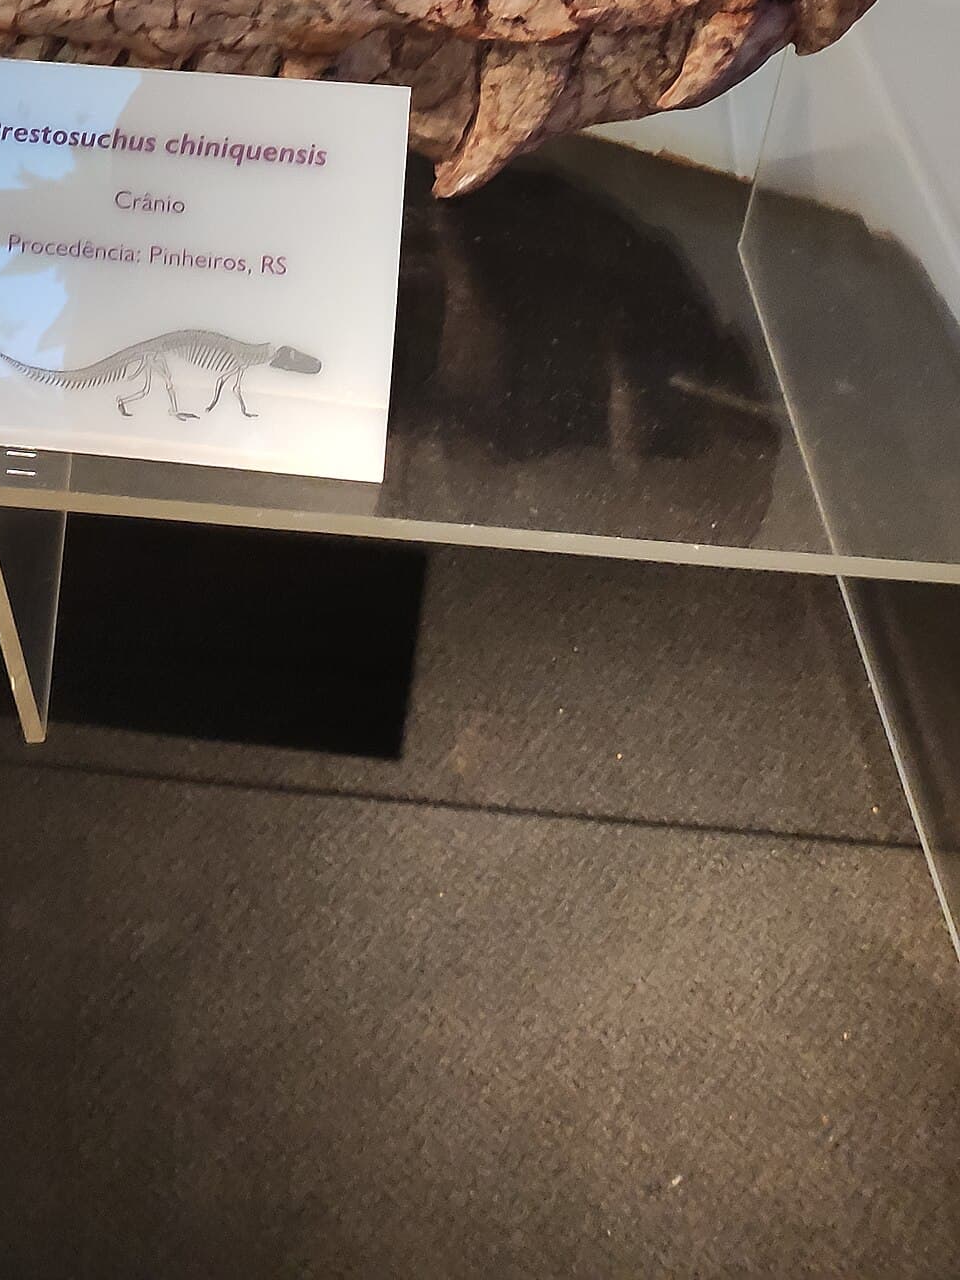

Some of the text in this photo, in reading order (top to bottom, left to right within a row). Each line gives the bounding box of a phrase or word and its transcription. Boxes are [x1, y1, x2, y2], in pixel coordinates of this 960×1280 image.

[165, 133, 328, 167] chiniquensis
[114, 190, 186, 214] Crânio
[7, 233, 288, 276] Procedência: Pinheiros, RS
